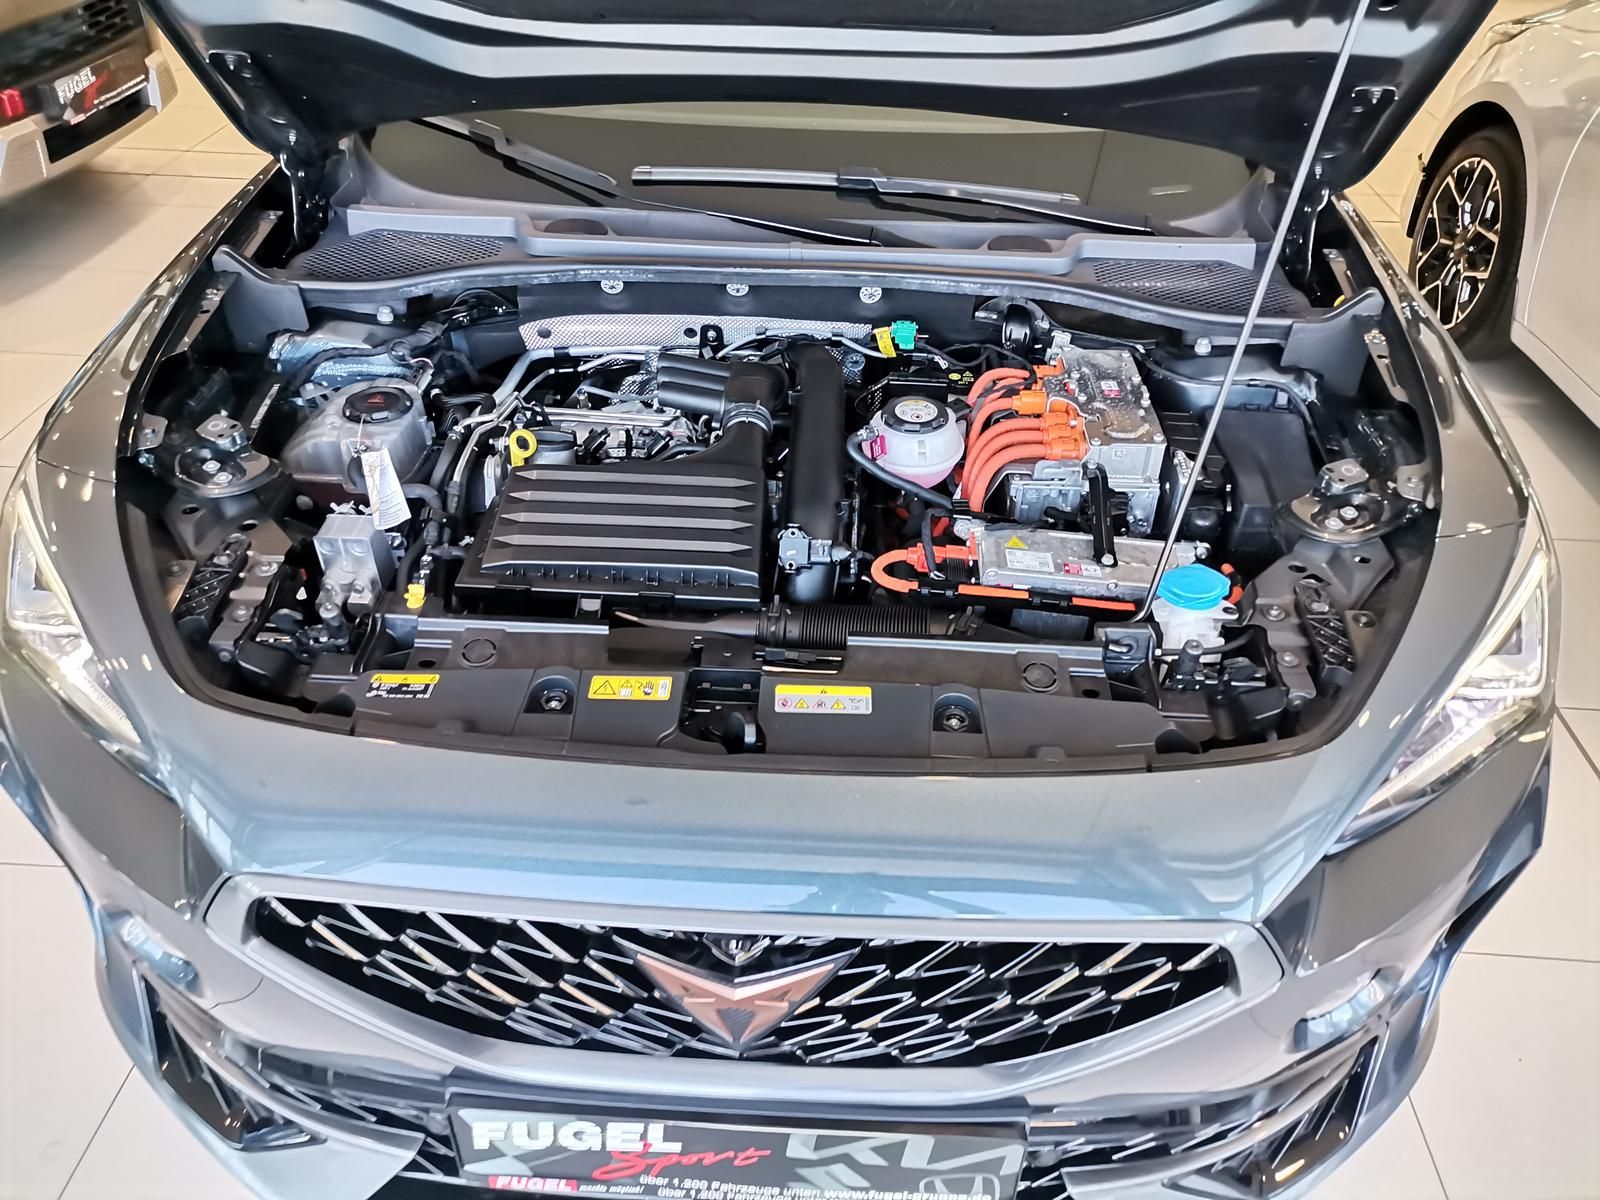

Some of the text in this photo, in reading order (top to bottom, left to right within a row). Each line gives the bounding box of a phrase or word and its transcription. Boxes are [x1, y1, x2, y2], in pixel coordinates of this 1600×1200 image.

[57, 66, 97, 105] FUGEL
[473, 1120, 683, 1153] FUGEL
[592, 1139, 772, 1181] Sport
[495, 1175, 575, 1193] FUGEL
